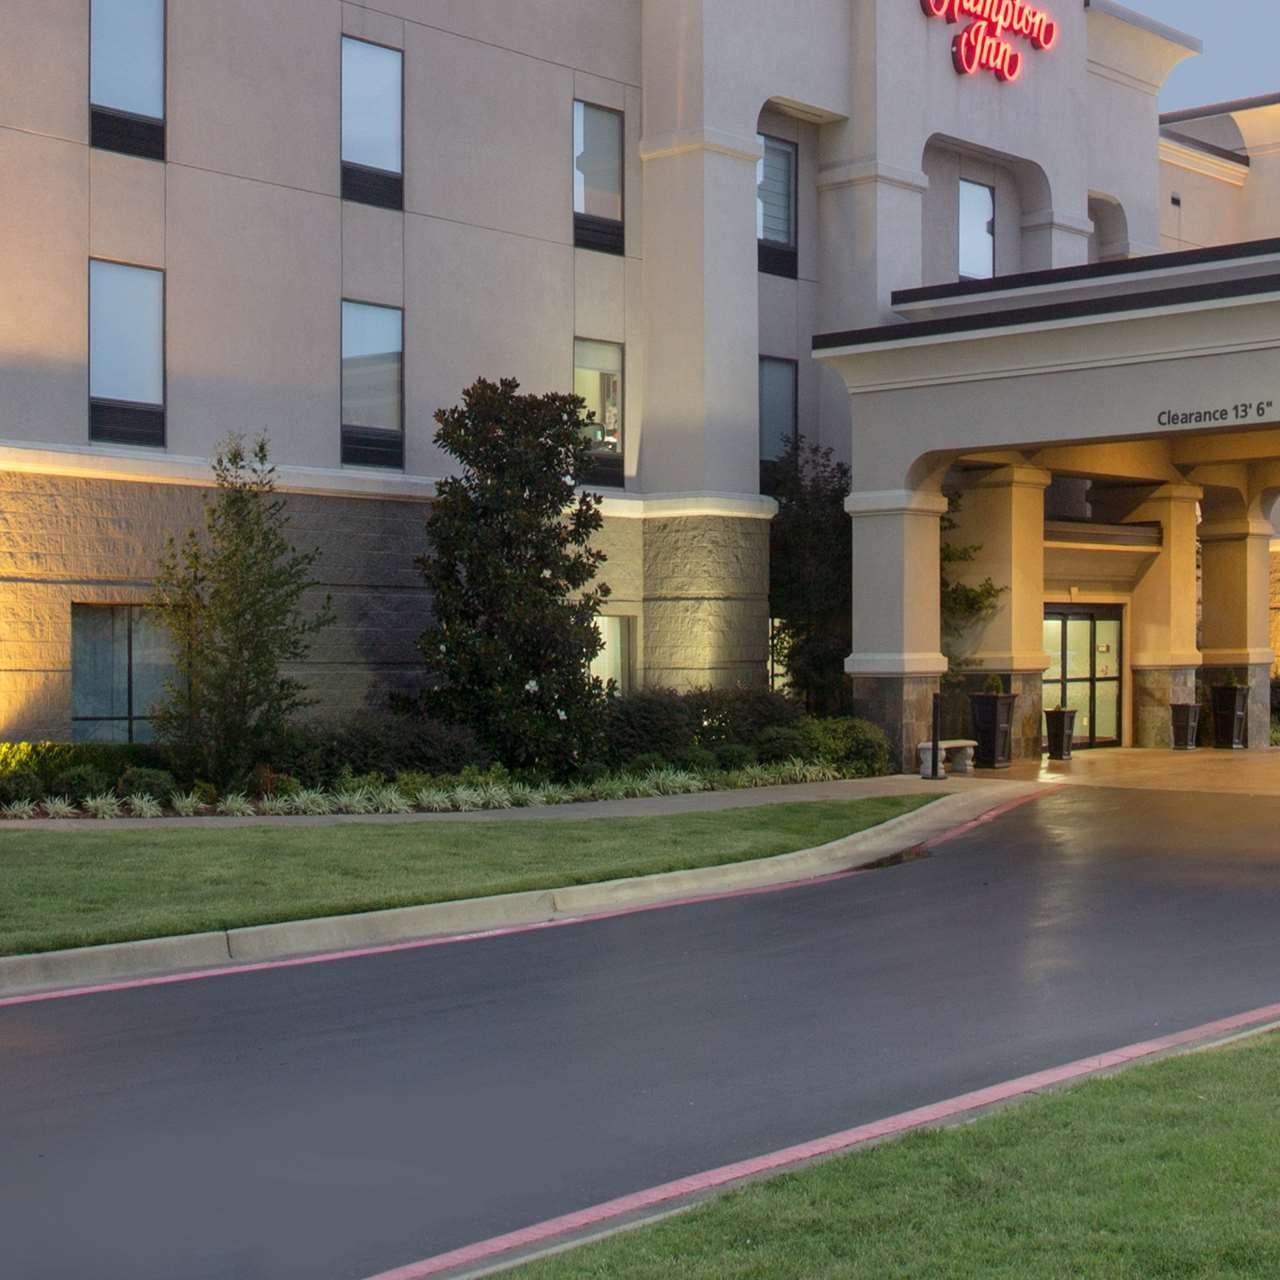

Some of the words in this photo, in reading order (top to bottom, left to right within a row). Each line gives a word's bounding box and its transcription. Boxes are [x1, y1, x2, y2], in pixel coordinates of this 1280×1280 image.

[959, 20, 1023, 81] Inn
[1157, 408, 1229, 426] Clearance
[1232, 403, 1253, 419] 13'
[1256, 401, 1273, 417] 6"
